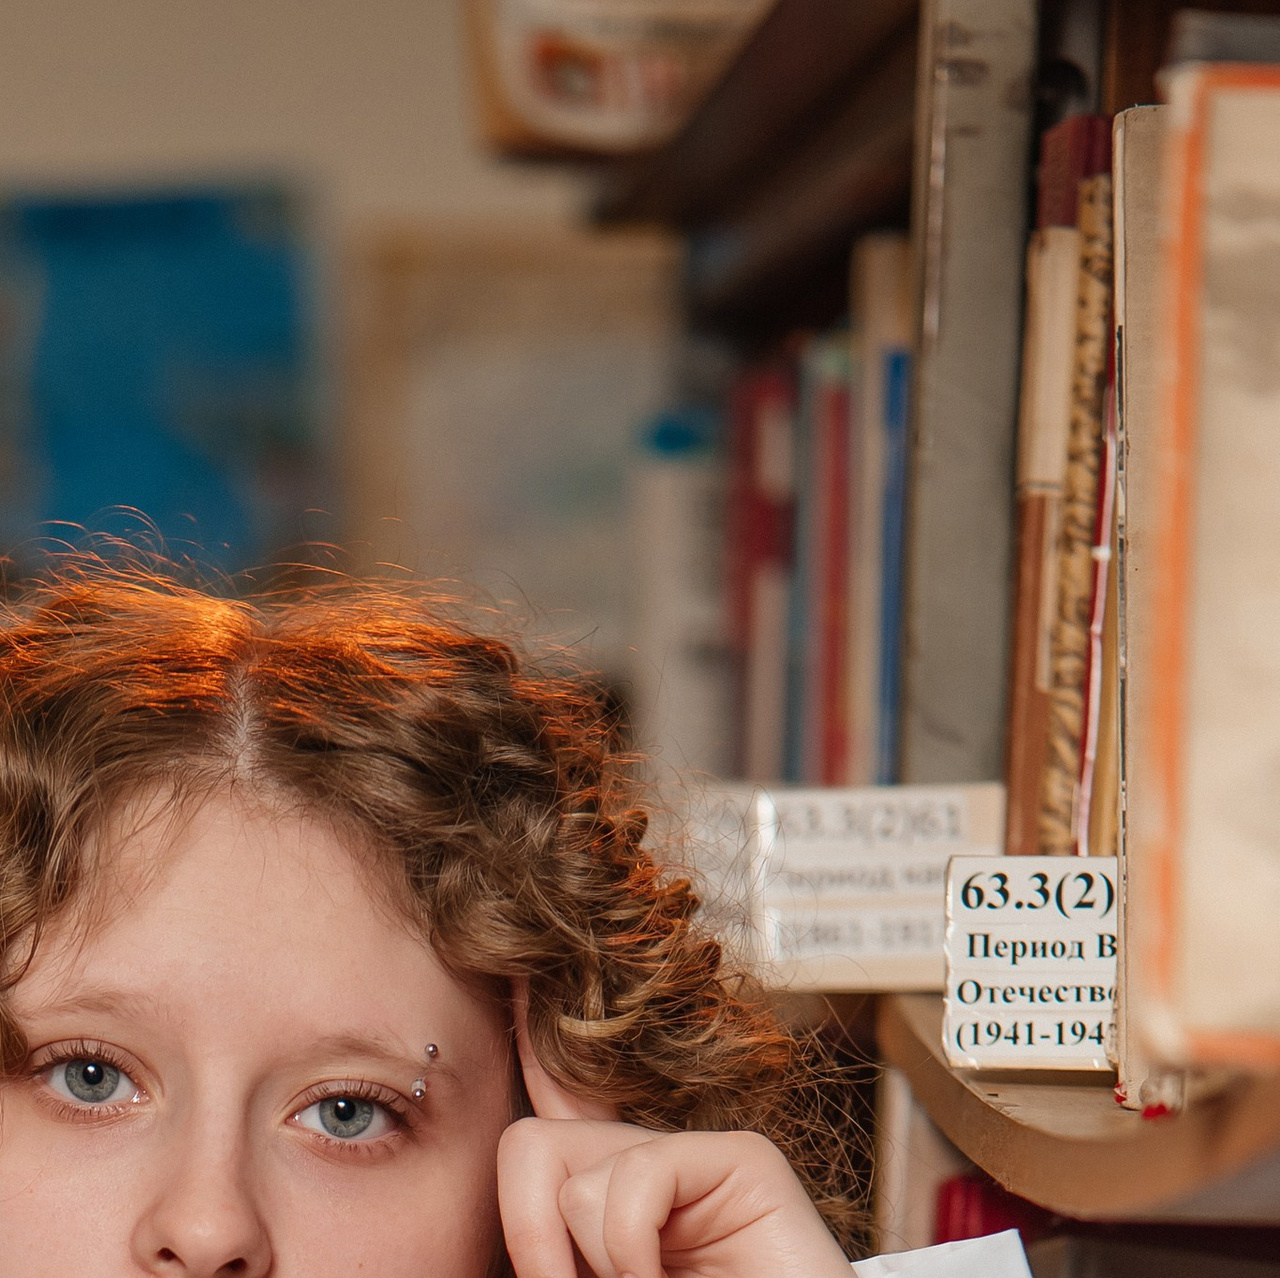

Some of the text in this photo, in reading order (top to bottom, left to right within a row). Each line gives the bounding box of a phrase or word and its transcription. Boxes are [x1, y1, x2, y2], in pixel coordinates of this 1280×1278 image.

[960, 870, 1116, 919] 63.3(2)
[966, 932, 1085, 966] Период
[1096, 933, 1117, 960] В
[955, 1020, 1116, 1053] (1941-194
